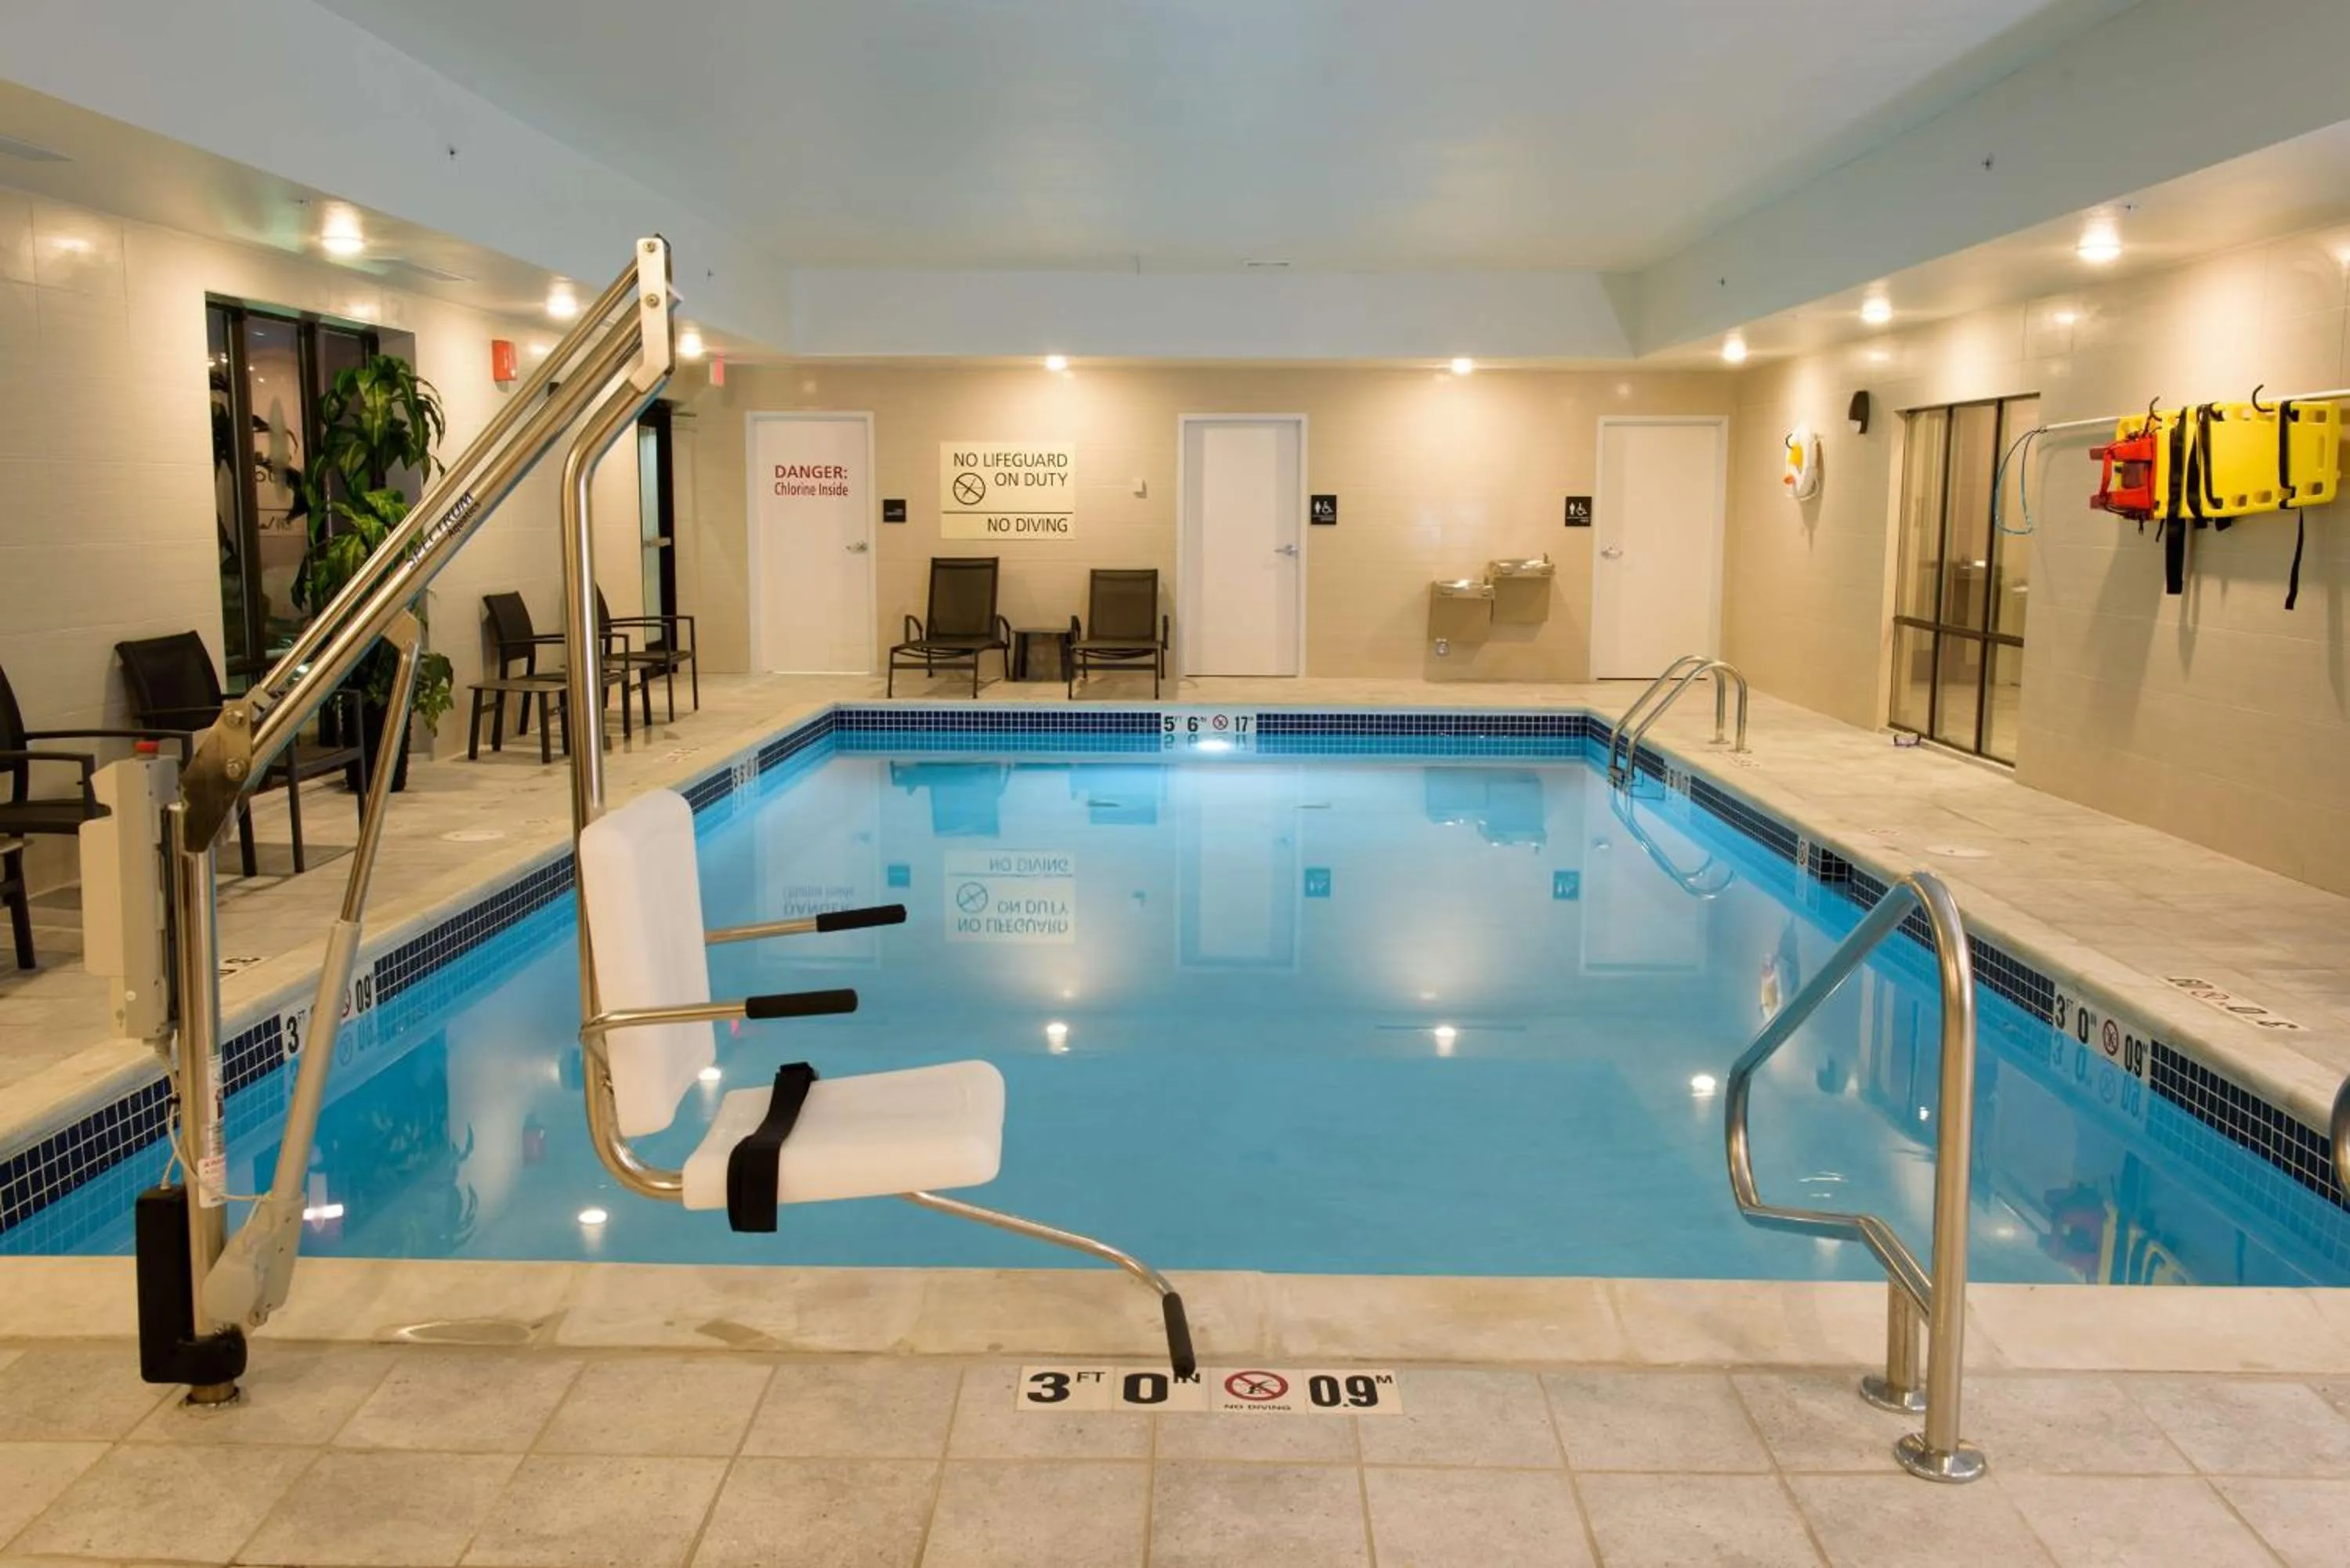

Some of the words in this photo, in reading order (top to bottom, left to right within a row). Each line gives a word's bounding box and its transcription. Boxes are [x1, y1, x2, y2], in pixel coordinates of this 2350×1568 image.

[953, 453, 978, 467] NO
[983, 453, 1068, 468] LIFEGUARD
[775, 464, 848, 479] DANGER:
[994, 472, 1018, 486] ON
[1025, 472, 1068, 486] DUTY
[775, 482, 816, 496] Chlorine
[819, 482, 848, 496] Inside
[987, 518, 1010, 533] NO
[1016, 518, 1068, 533] DIVING
[1164, 715, 1175, 732] 5
[1188, 716, 1198, 732] 6
[2055, 994, 2066, 1030] 3
[2078, 1006, 2088, 1044] 0
[287, 1016, 299, 1053] 3
[1027, 1371, 1070, 1404] 3
[1076, 1371, 1107, 1382] FT
[1123, 1373, 1168, 1404] 0
[1309, 1375, 1379, 1407] 0.9
[1376, 1375, 1393, 1384] M
